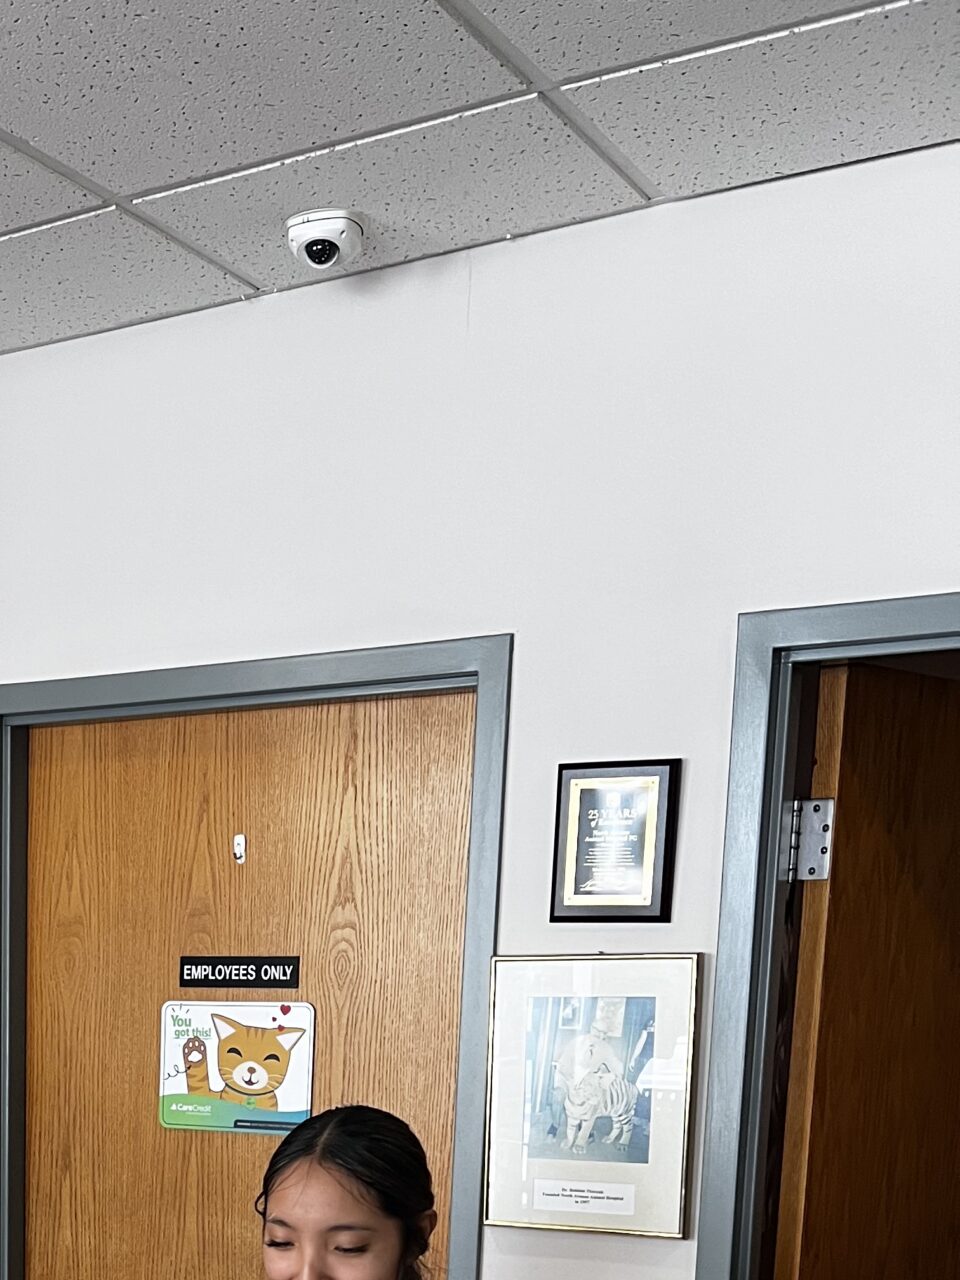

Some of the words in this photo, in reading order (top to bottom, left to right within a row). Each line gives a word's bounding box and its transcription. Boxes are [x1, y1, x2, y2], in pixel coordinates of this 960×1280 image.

[183, 965, 256, 981] EMPLOYEES
[261, 965, 293, 980] ONLY
[170, 1014, 192, 1028] You
[174, 1029, 190, 1039] got
[192, 1027, 212, 1038] this!
[177, 1103, 213, 1113] CareCredit
